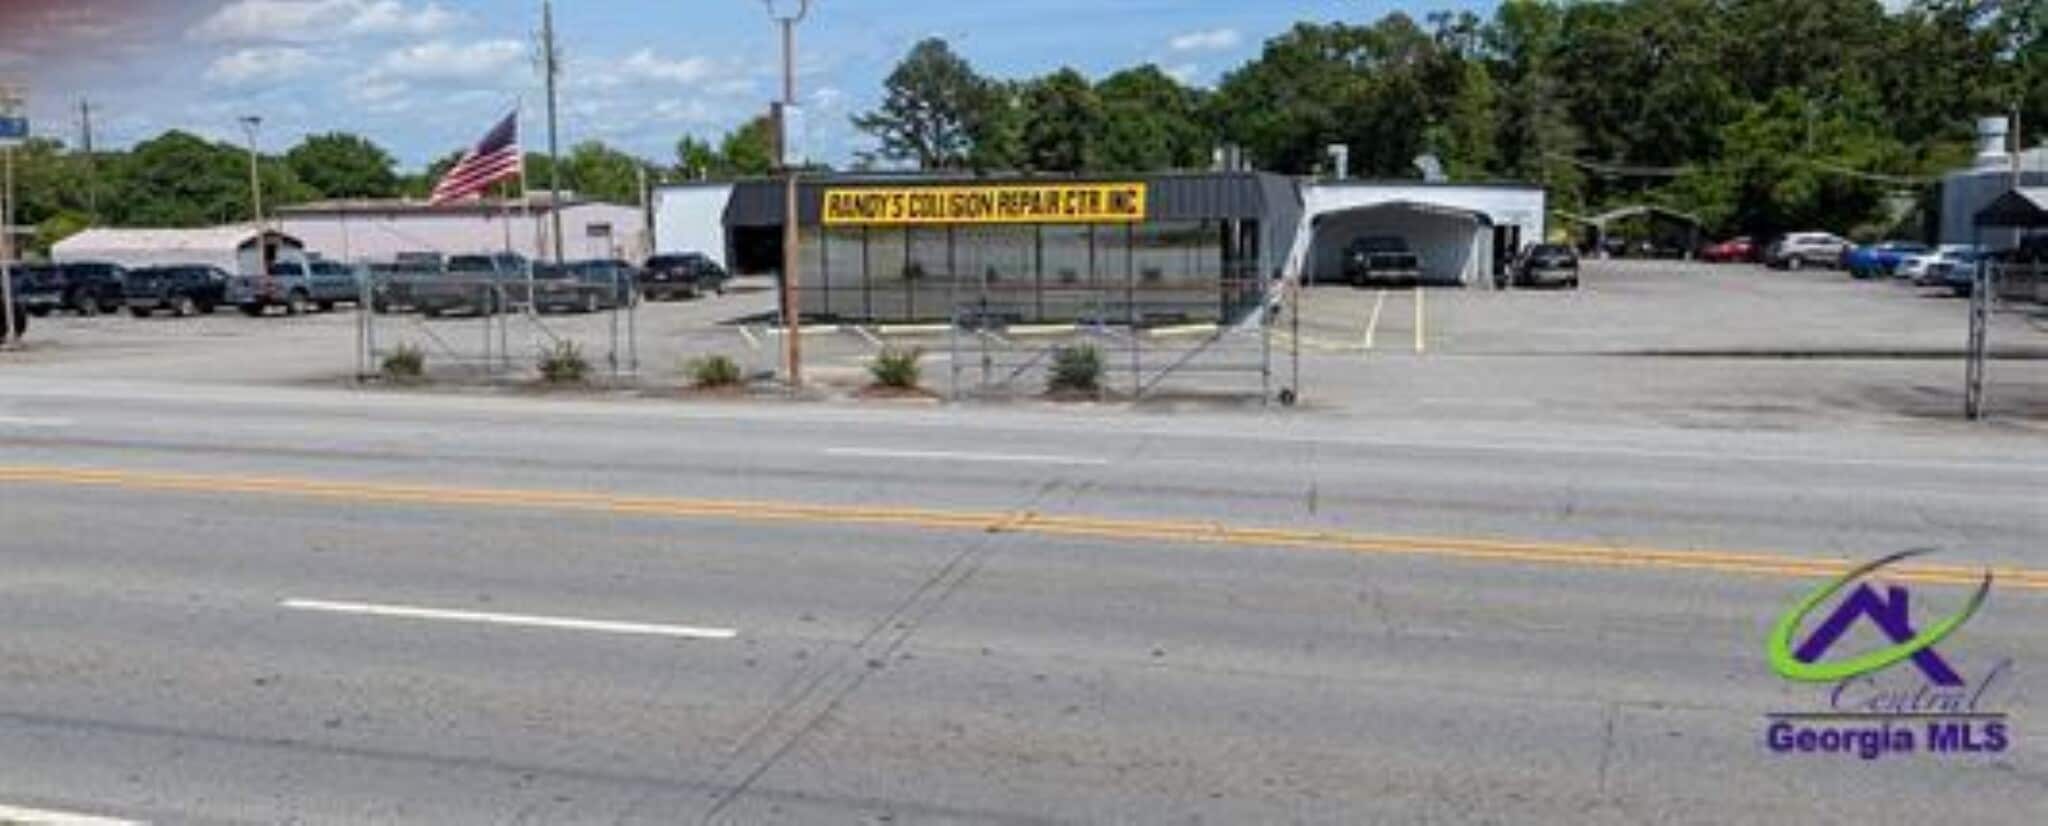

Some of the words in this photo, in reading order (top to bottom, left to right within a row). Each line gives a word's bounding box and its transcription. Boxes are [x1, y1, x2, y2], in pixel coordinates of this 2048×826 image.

[827, 192, 903, 218] RANDY'S
[909, 192, 993, 218] COLLISION
[998, 190, 1059, 216] REPAIR
